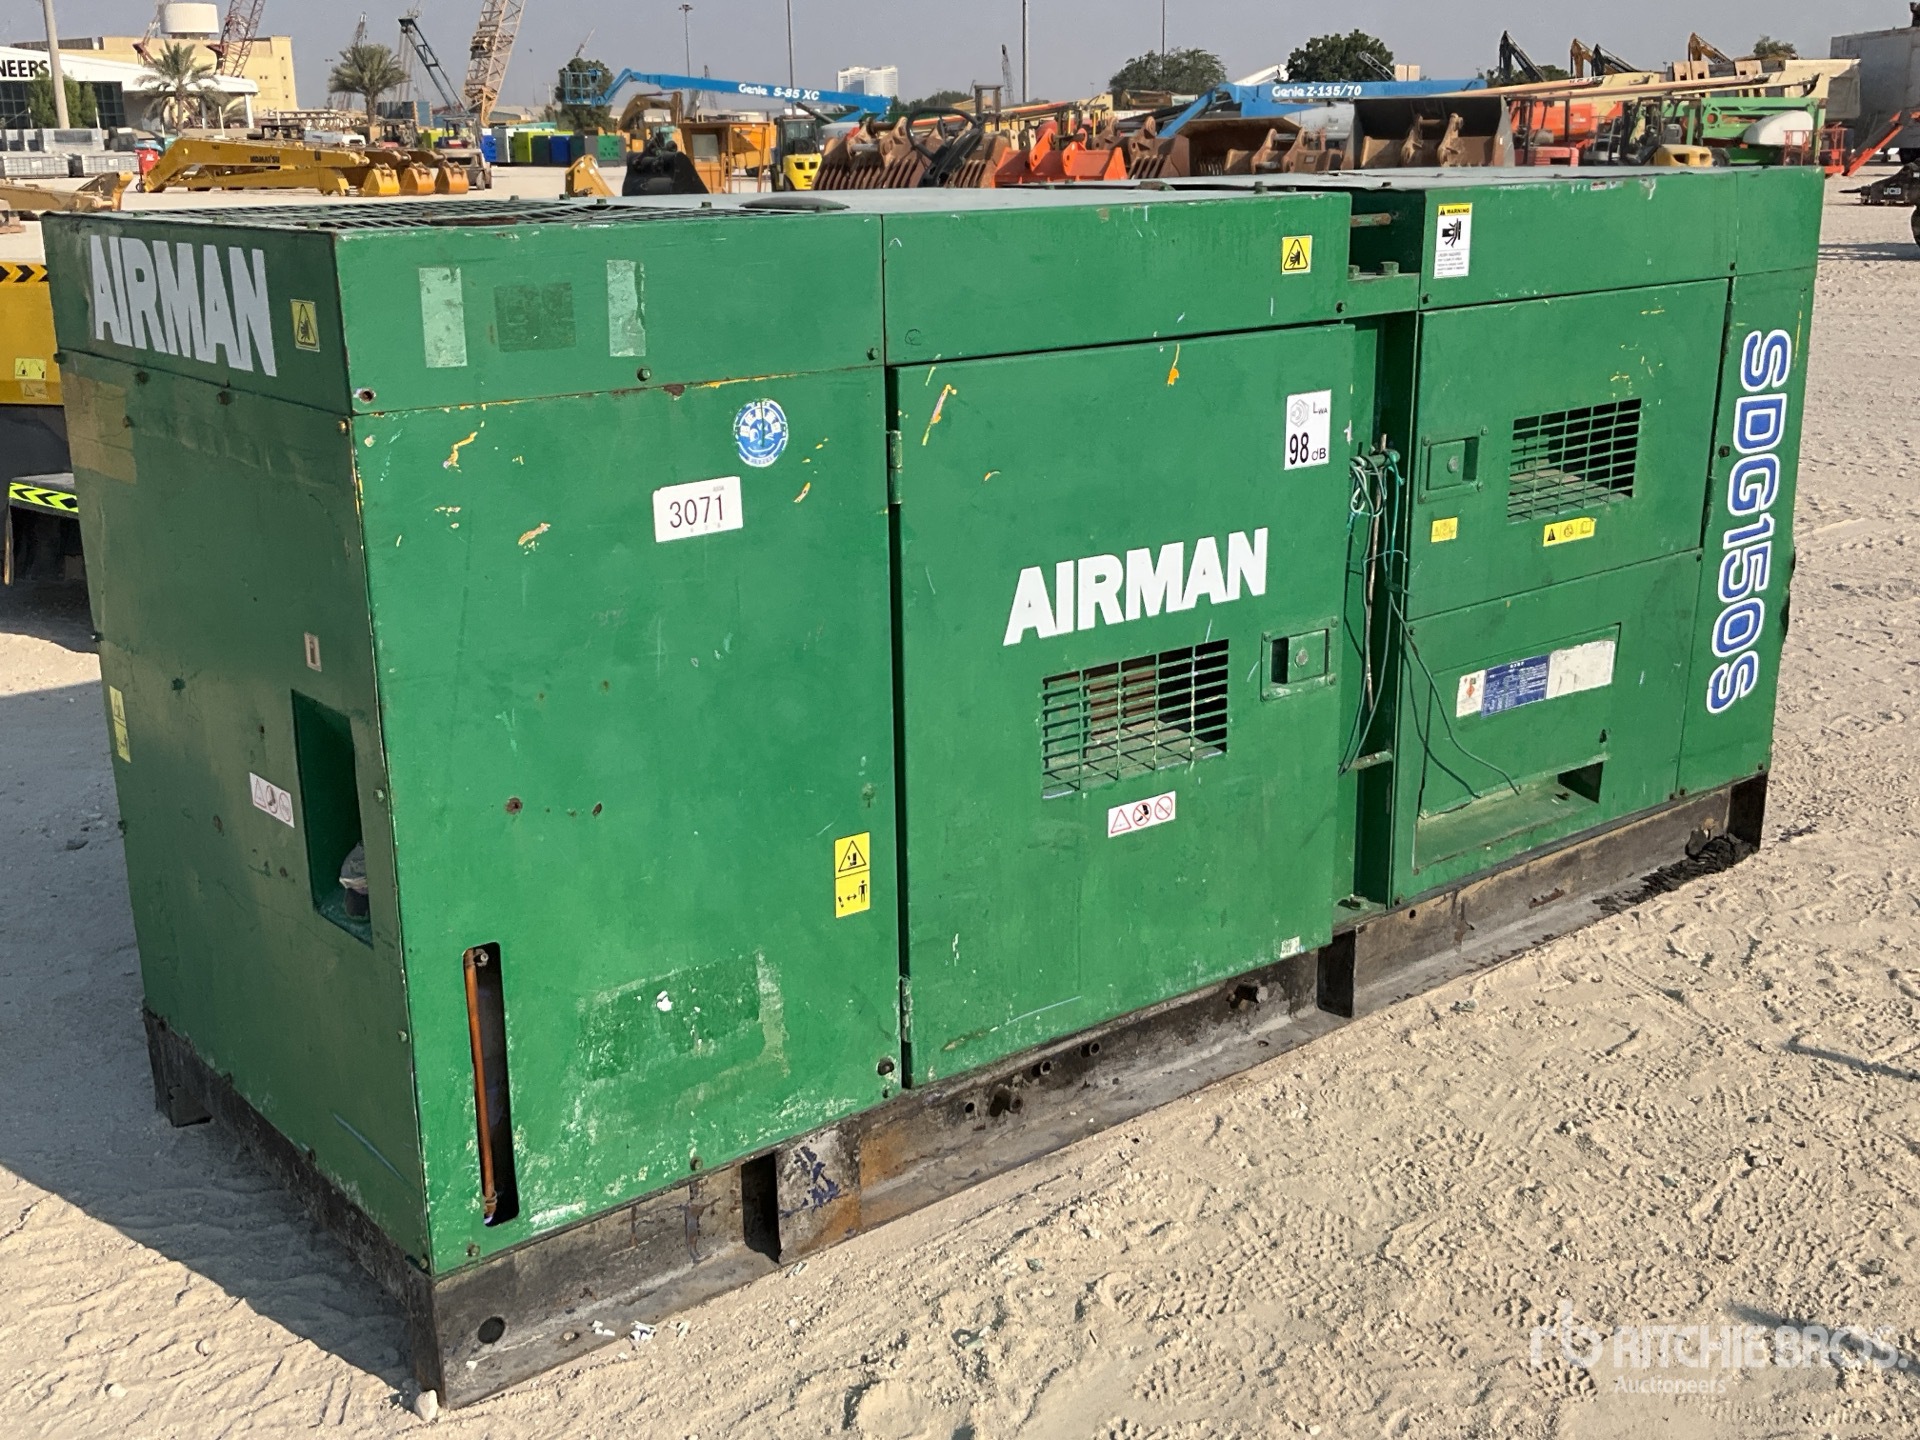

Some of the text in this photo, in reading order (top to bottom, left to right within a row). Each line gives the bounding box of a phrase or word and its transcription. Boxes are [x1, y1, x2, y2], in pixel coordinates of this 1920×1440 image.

[738, 83, 820, 101] Genie S-85 XC
[1272, 84, 1362, 98] Genie Z-135/70
[1883, 187, 1902, 196] JCB
[1446, 207, 1470, 215] WARNING
[90, 234, 277, 377] AIRMAN
[1289, 432, 1327, 465] 98 dB
[669, 493, 723, 529] 3071
[1706, 328, 1792, 714] SDG150S
[1003, 527, 1268, 646] AIRMAN
